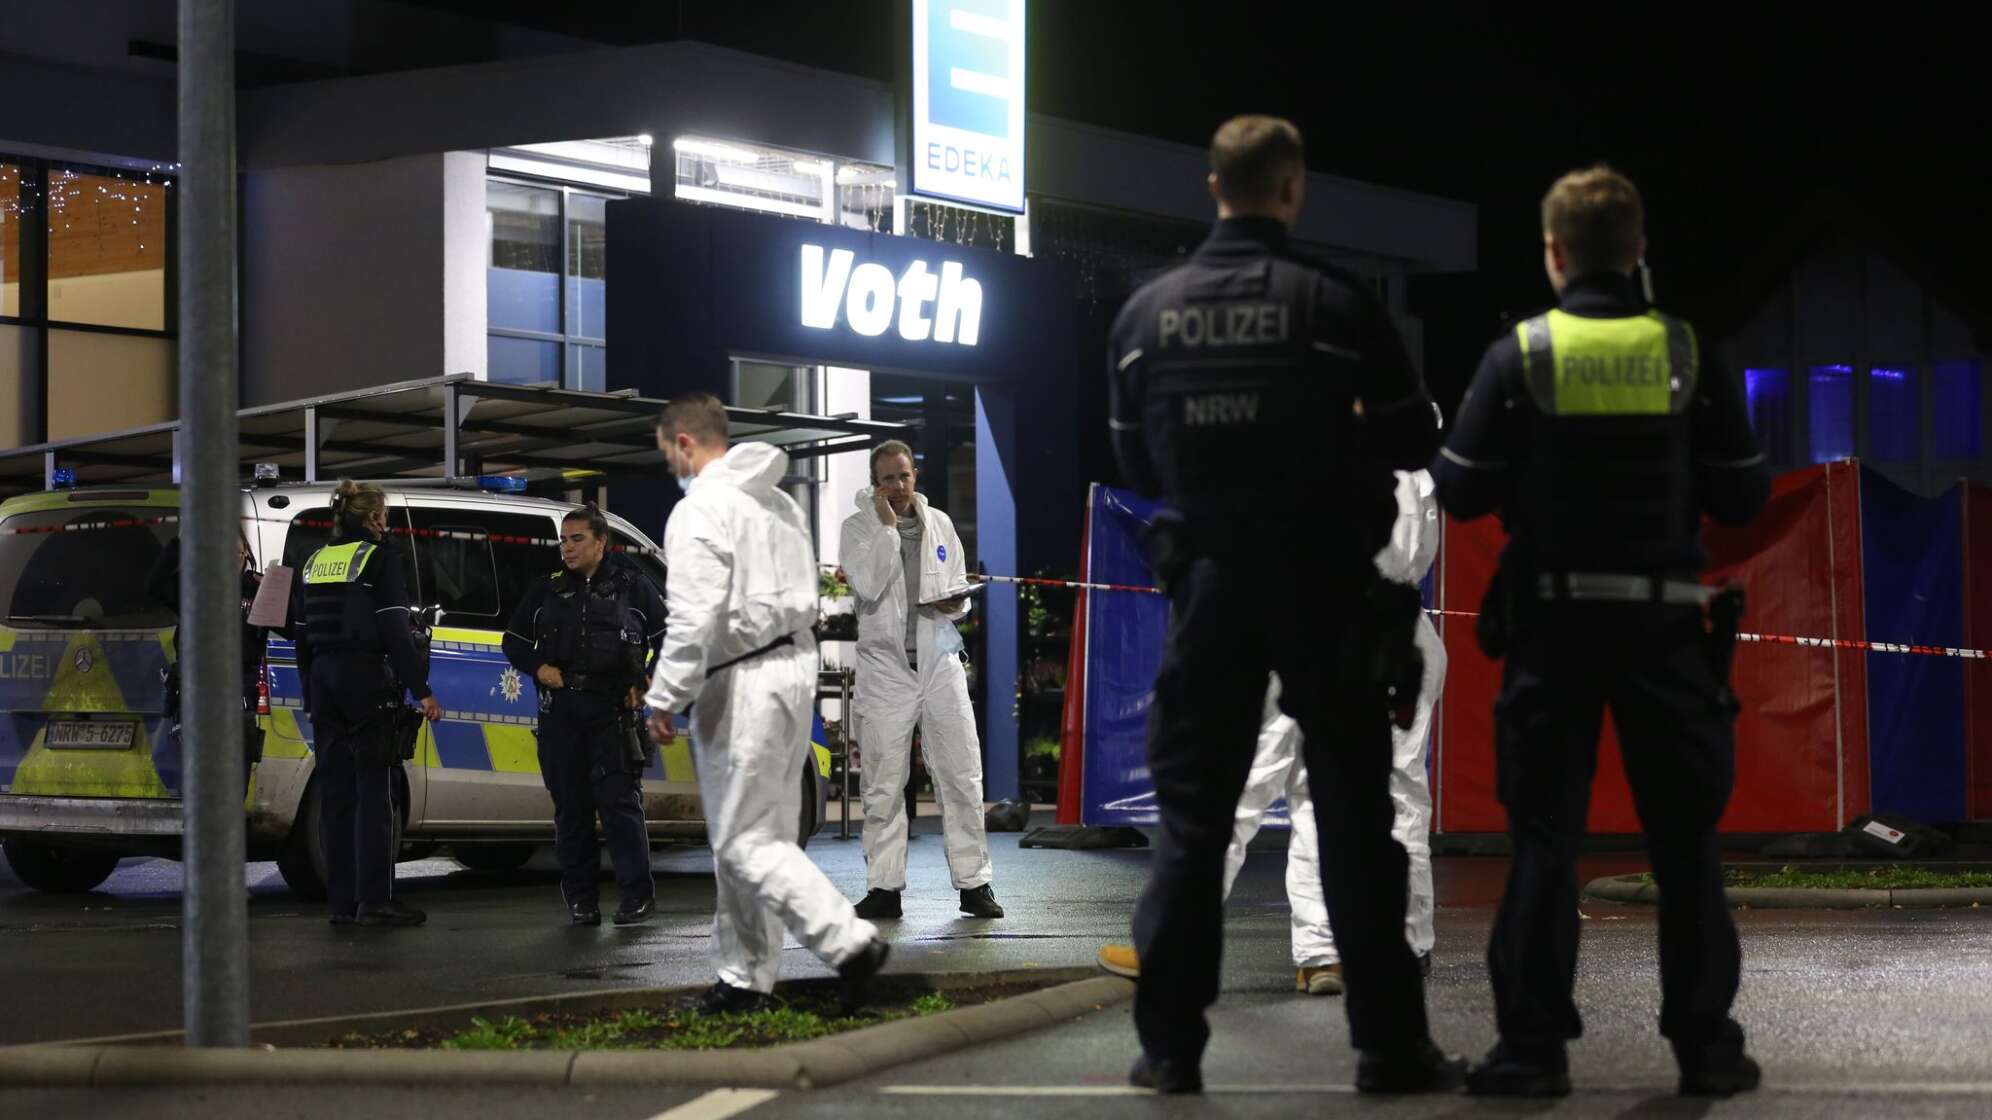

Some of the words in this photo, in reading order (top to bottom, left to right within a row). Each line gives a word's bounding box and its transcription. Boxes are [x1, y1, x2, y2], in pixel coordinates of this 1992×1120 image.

[928, 142, 1011, 184] EDEKA
[801, 243, 982, 346] Voth
[1158, 305, 1289, 347] POLIZEI
[1563, 355, 1663, 387] POLIZEI
[1184, 392, 1260, 426] NRW
[311, 561, 348, 578] POLIZEI
